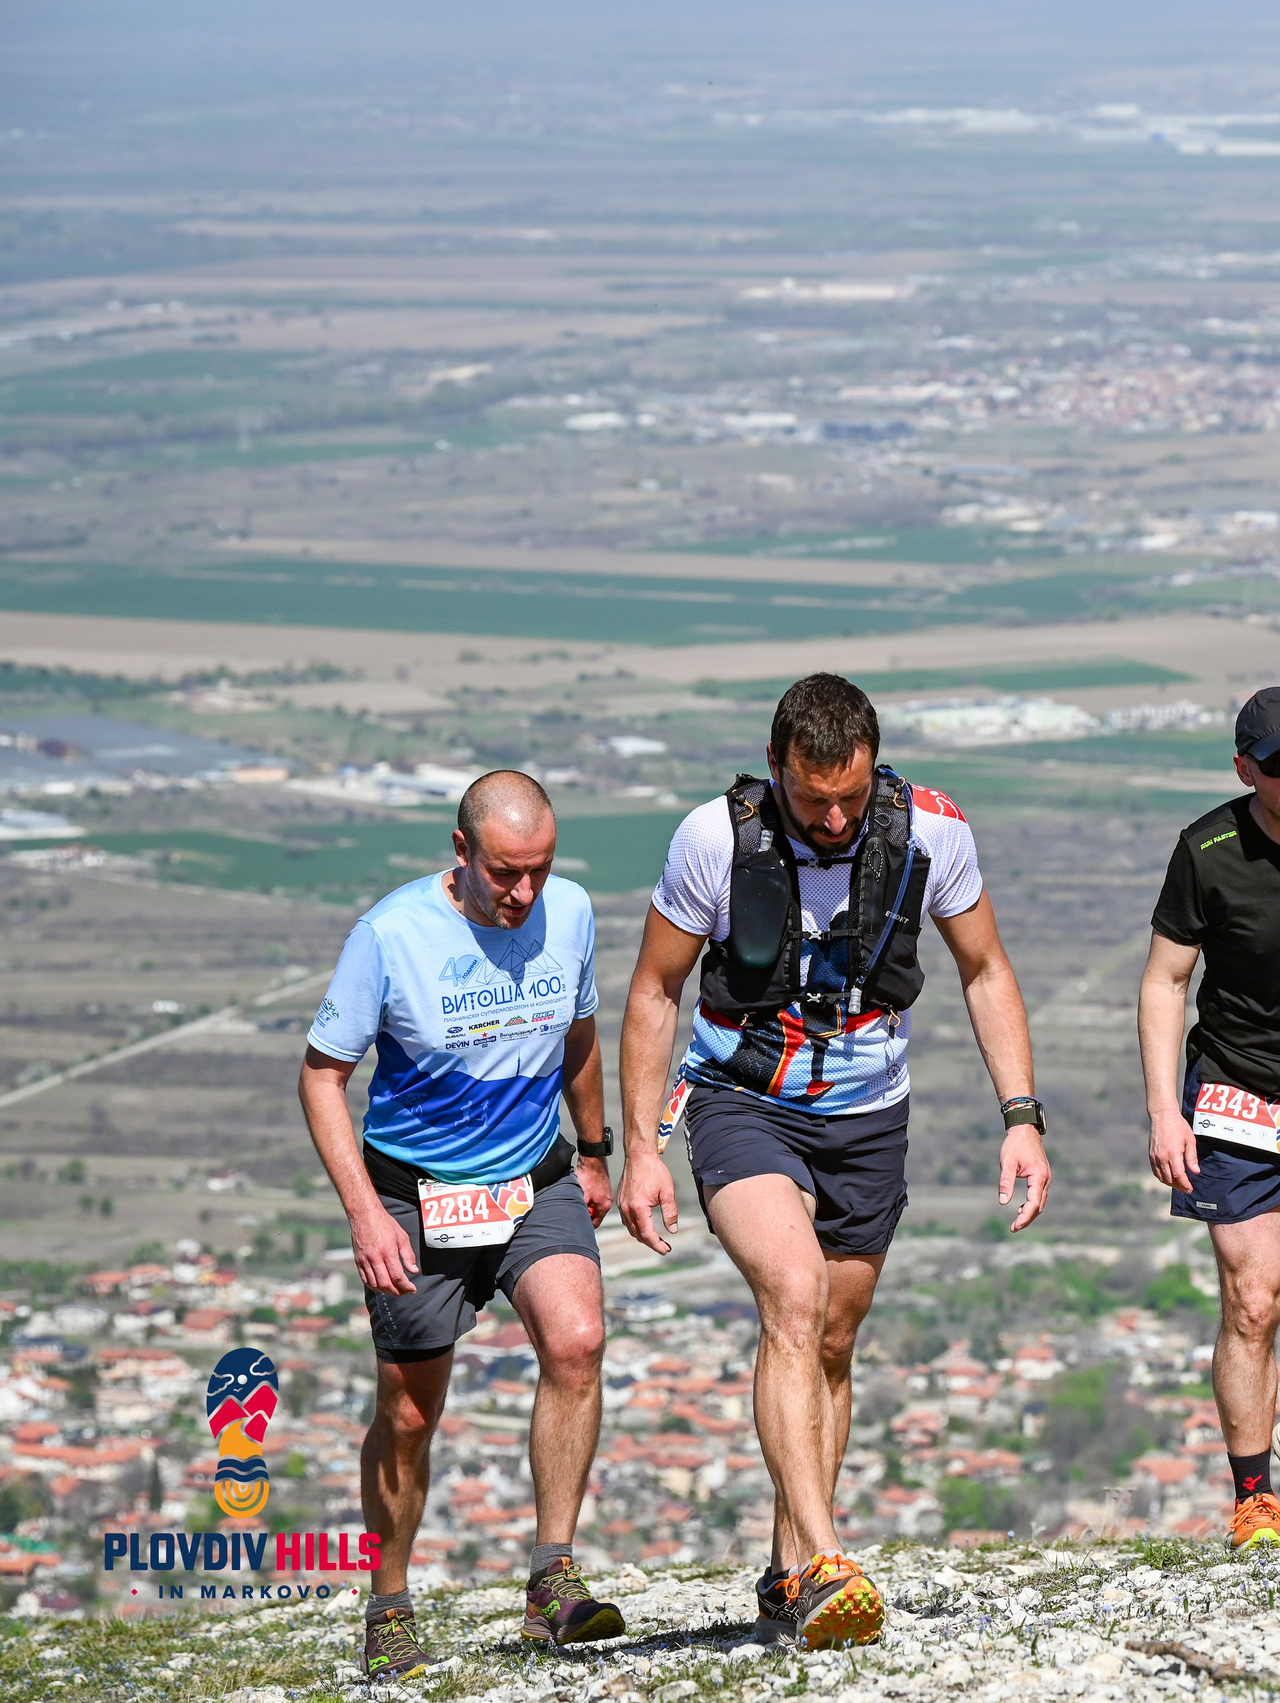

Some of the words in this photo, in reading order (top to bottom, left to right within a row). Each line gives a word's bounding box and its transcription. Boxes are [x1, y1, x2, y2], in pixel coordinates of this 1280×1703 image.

[441, 983, 525, 1015] ВИТОША
[528, 976, 561, 999] 100
[480, 1002, 529, 1017] супермаратон
[445, 1040, 470, 1050] DEVIN
[1198, 1083, 1260, 1120] 2343
[424, 1193, 489, 1226] 2284
